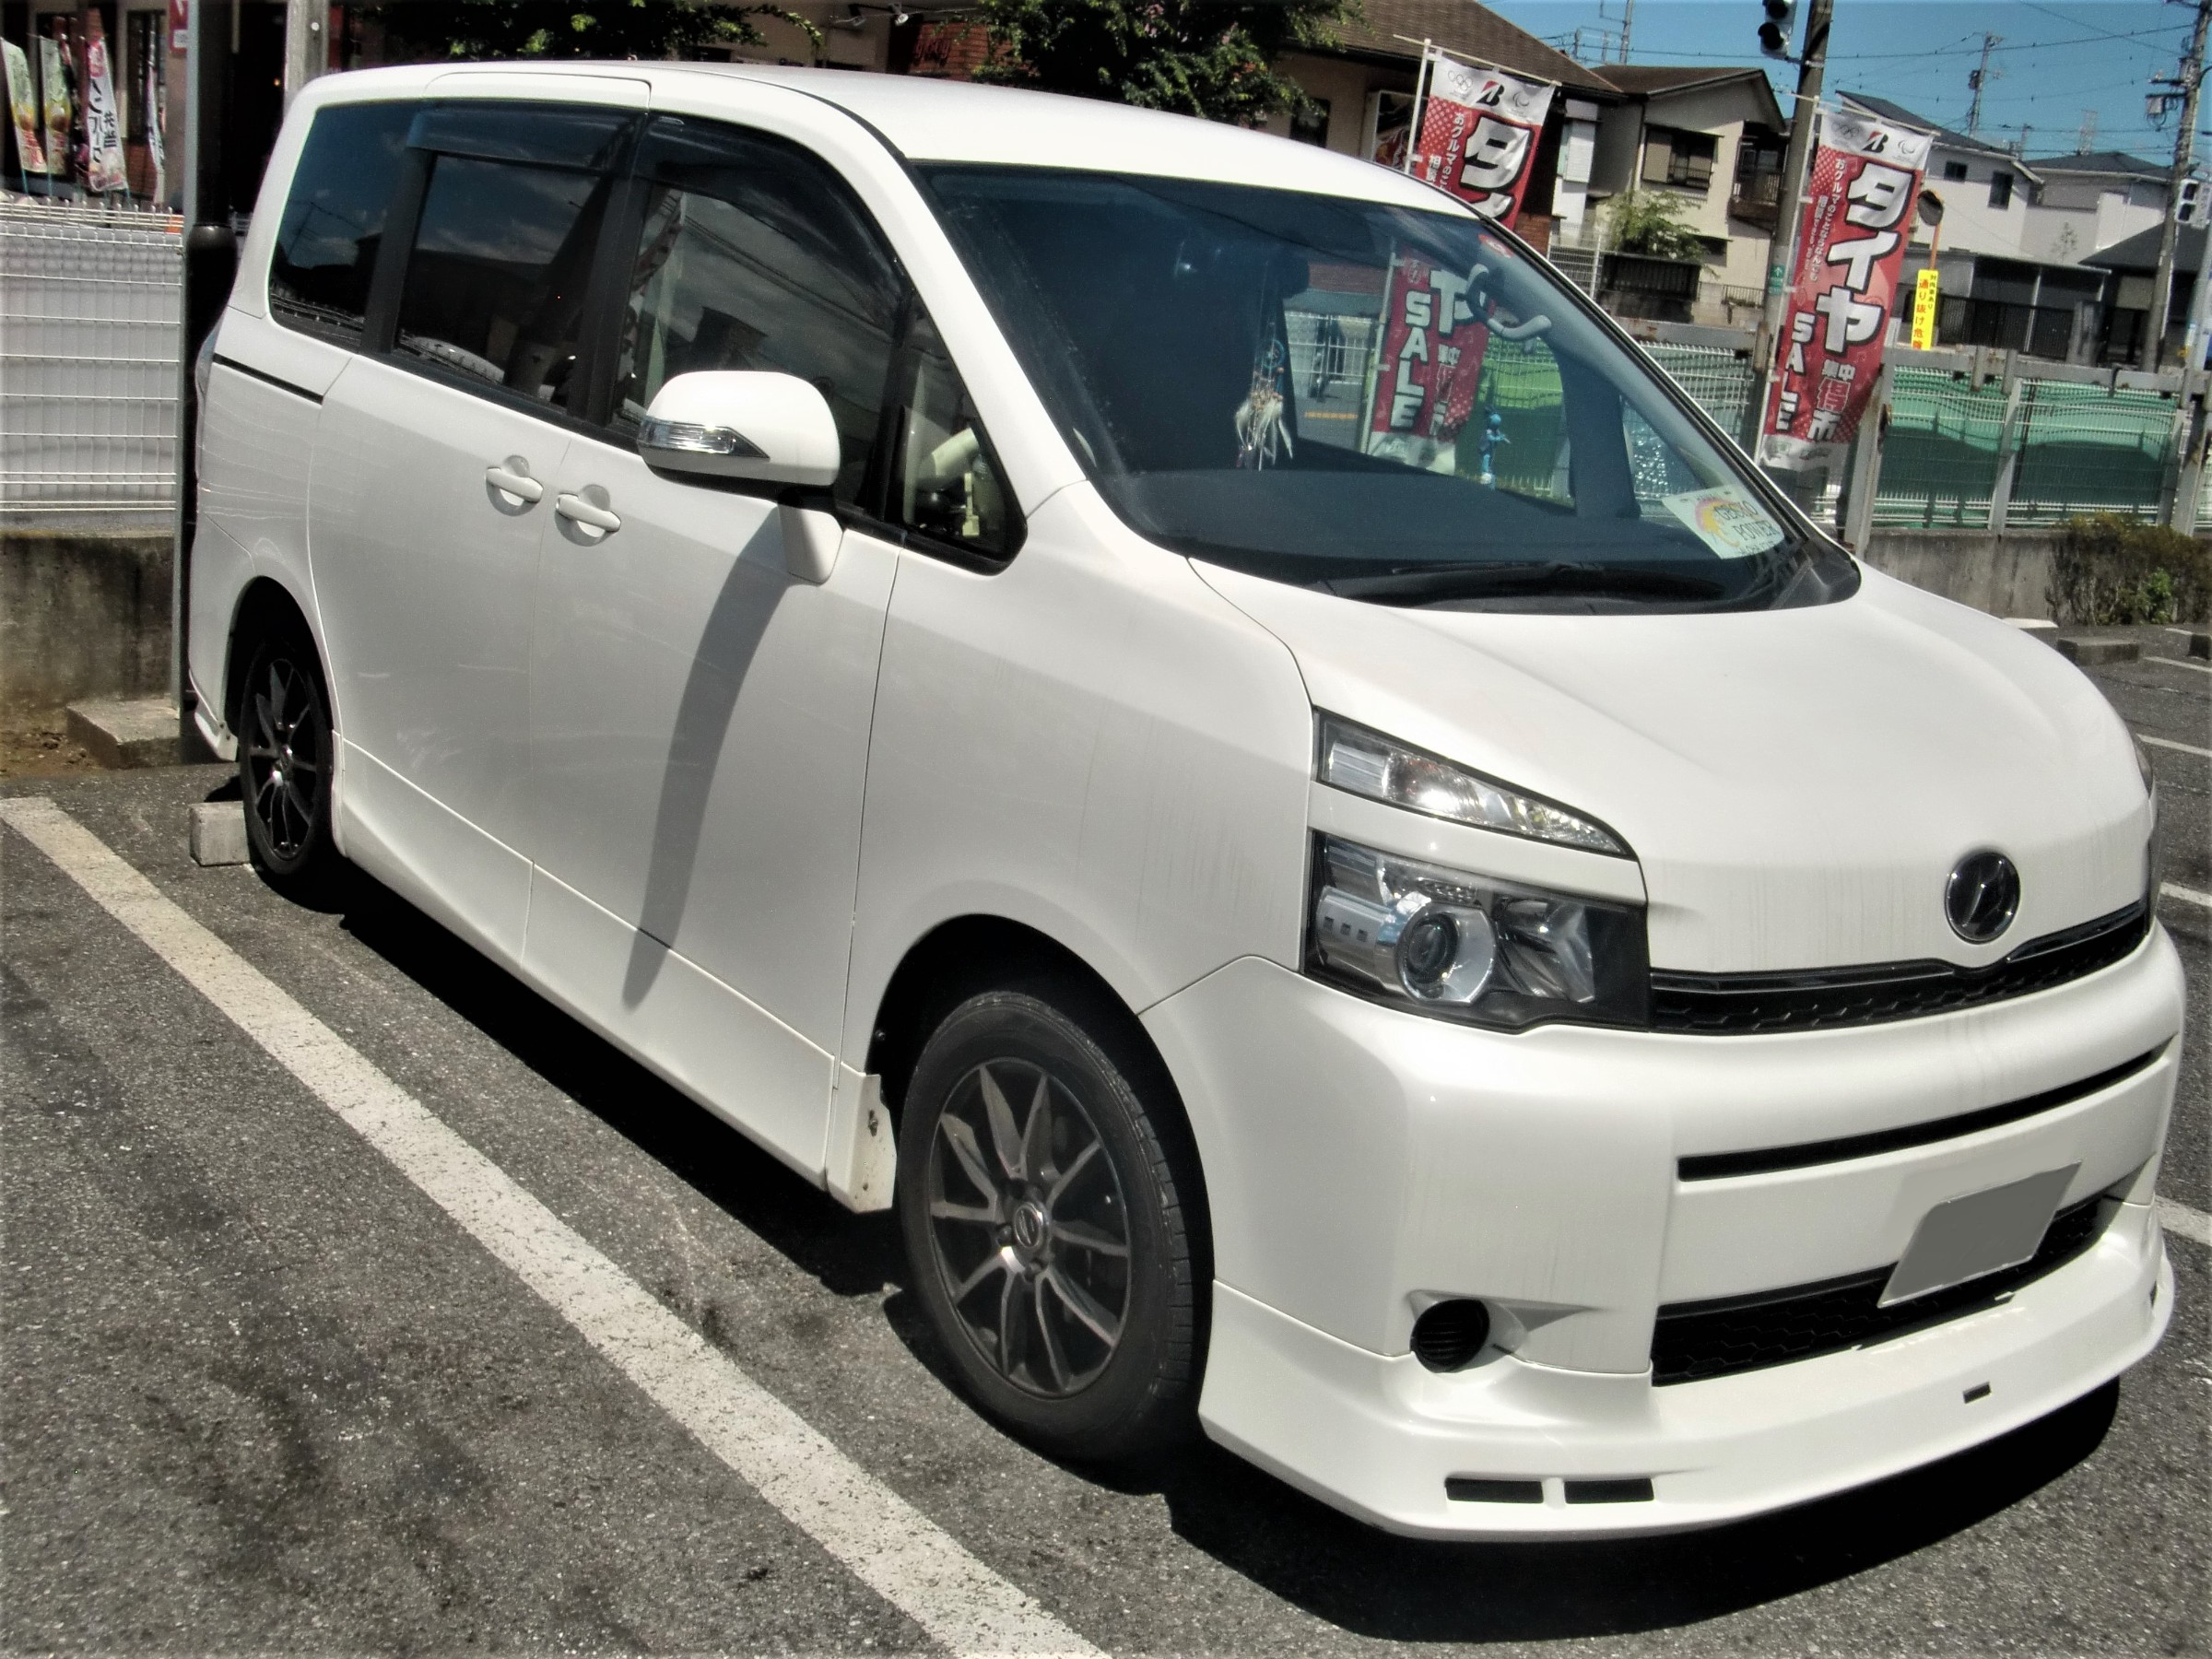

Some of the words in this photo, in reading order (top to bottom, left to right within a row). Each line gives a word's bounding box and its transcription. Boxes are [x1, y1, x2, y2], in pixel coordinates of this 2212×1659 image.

[1816, 162, 1914, 354] タイヤ
[1390, 289, 1431, 429] SALE
[1775, 312, 1816, 430] SALE
